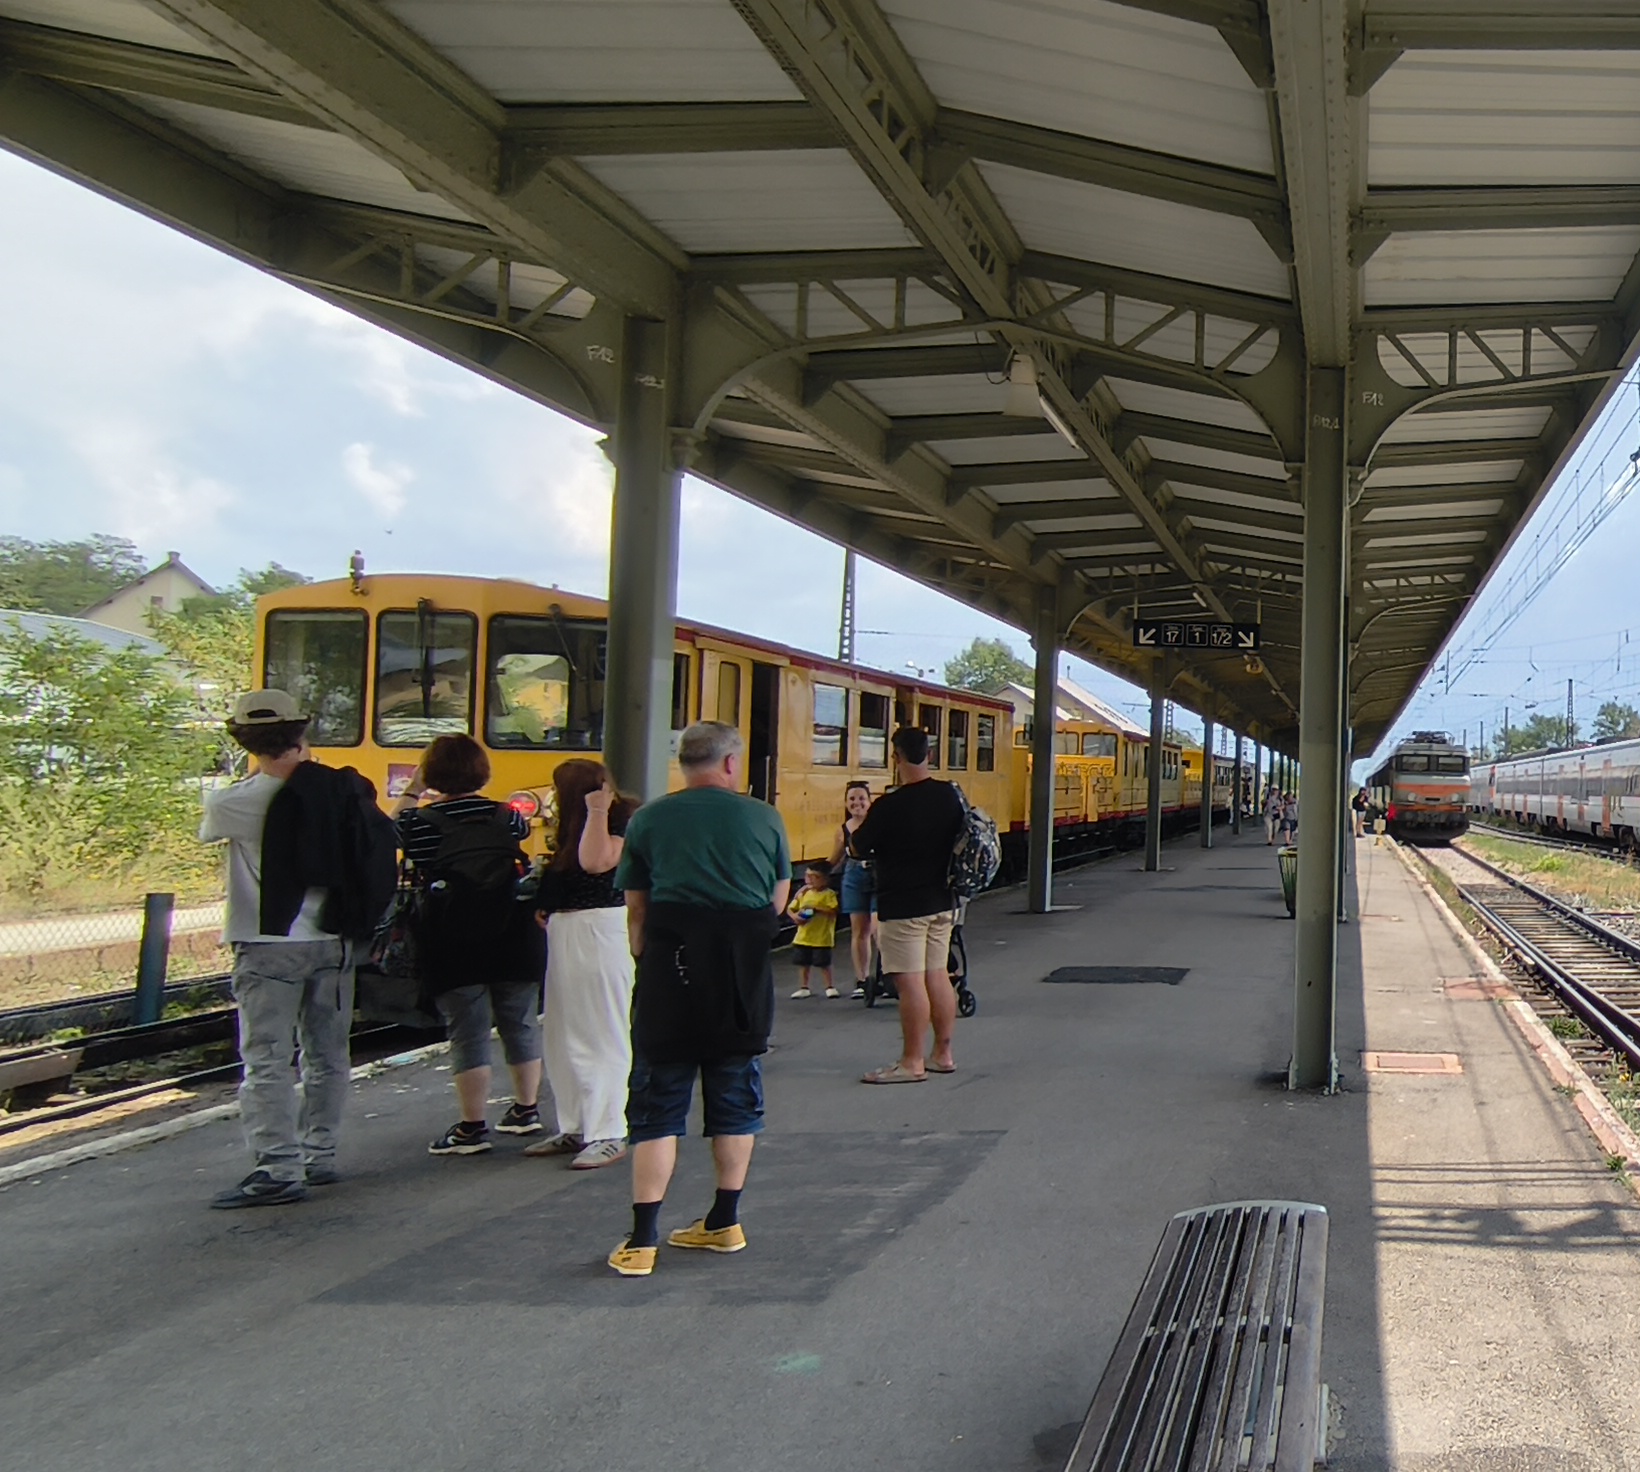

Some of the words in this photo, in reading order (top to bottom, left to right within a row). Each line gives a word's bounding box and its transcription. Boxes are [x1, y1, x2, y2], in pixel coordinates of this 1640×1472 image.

[1166, 631, 1179, 643] 17
[1194, 631, 1200, 643] 1
[1212, 632, 1232, 645] 1/2
